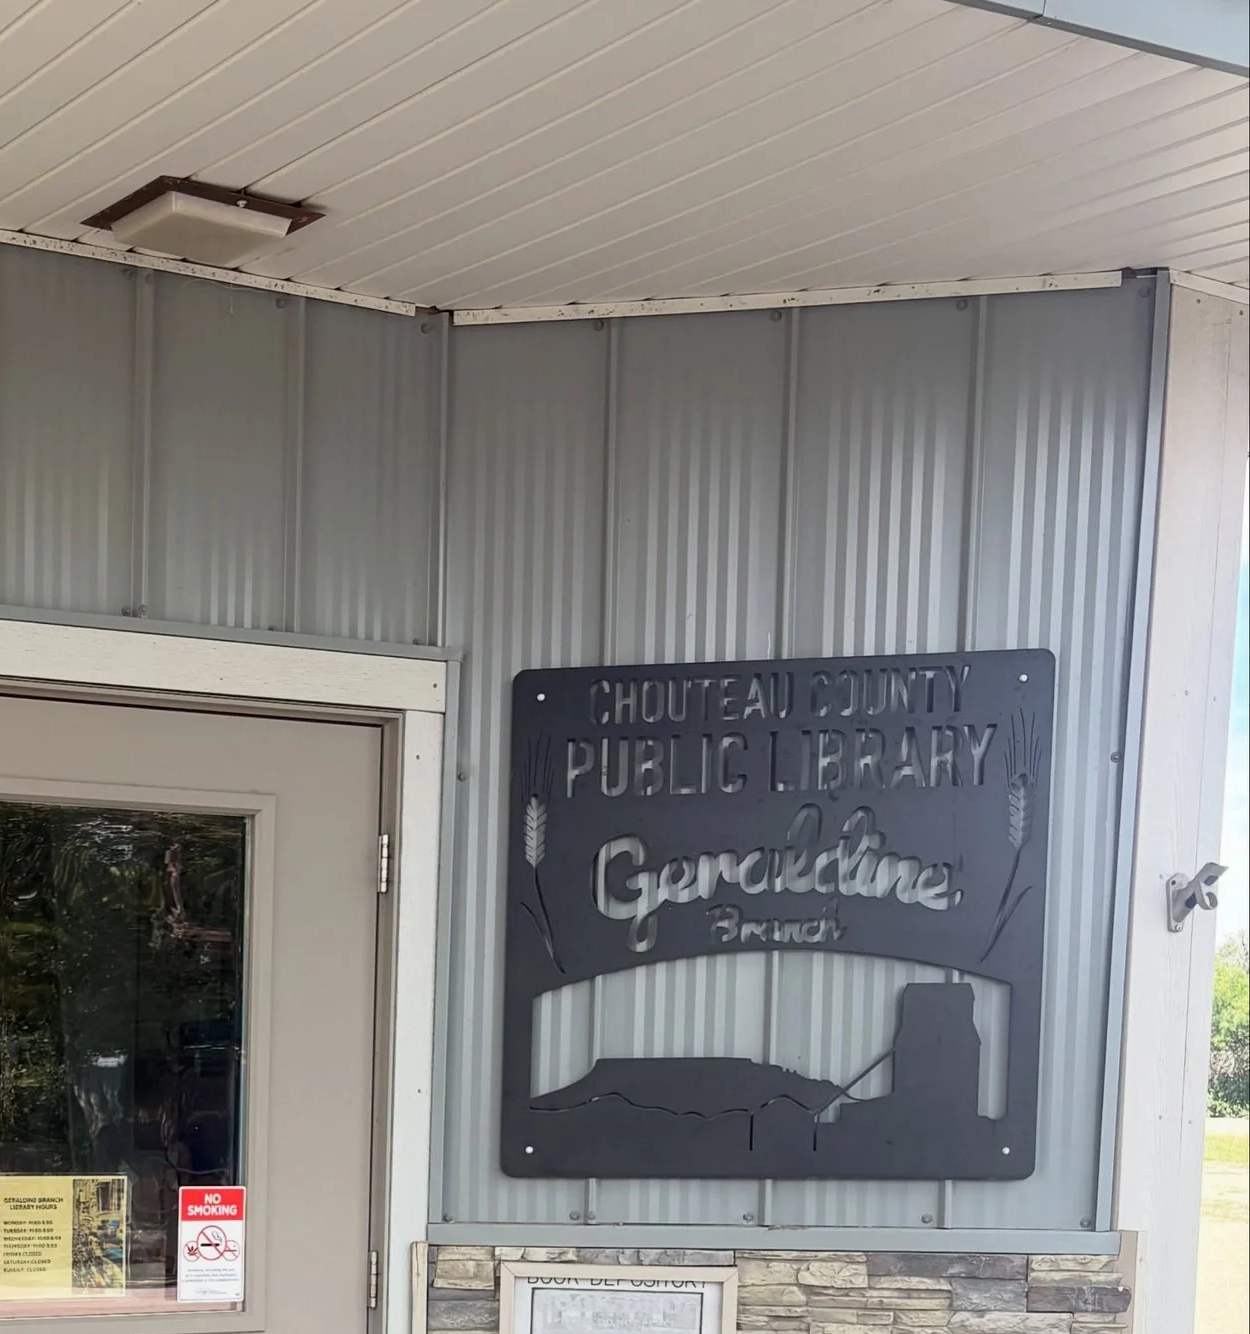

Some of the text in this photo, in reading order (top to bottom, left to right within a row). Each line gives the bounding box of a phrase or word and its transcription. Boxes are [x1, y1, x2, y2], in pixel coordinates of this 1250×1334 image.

[589, 664, 972, 726] CHOUTEAU COUNTY
[566, 723, 999, 800] PUBLIC LIBRARY
[592, 802, 964, 954] Geraldine
[706, 900, 846, 944] Branch
[187, 1203, 239, 1217] SMOKING
[204, 1193, 222, 1205] NO
